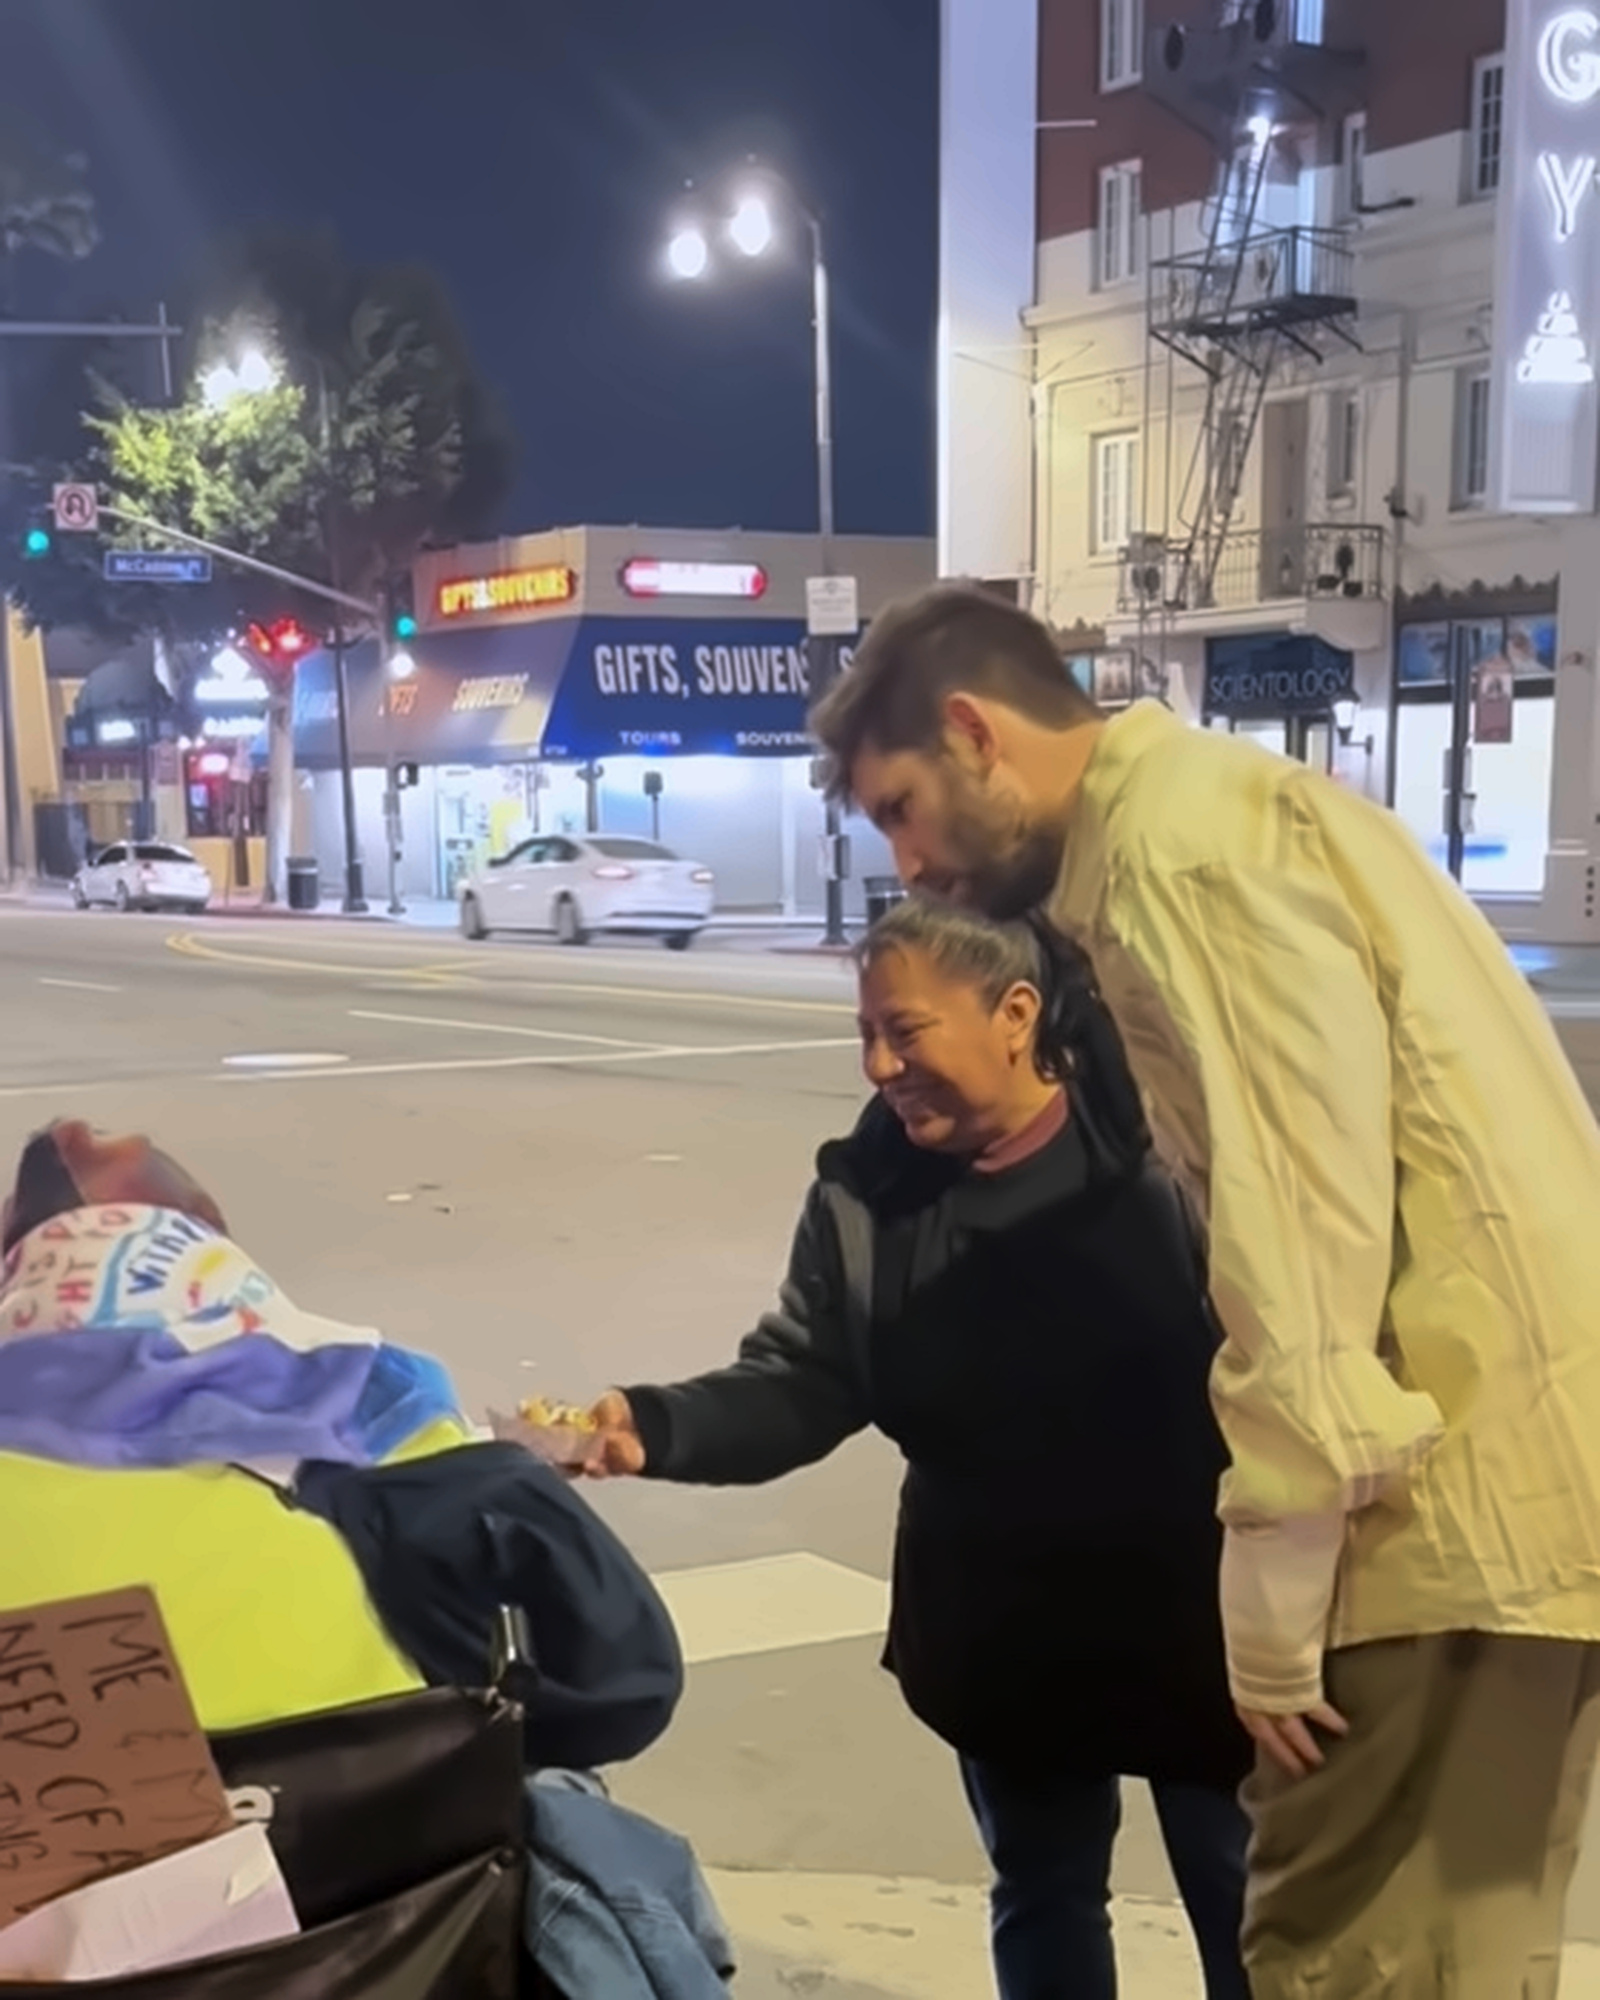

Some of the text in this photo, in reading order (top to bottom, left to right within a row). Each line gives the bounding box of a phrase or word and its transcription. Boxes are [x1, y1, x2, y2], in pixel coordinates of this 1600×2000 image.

[595, 645, 690, 699] GIFTS,
[1210, 667, 1350, 702] SCIENTOLOGY
[619, 730, 682, 746] TOURS
[61, 1611, 172, 1702] ME
